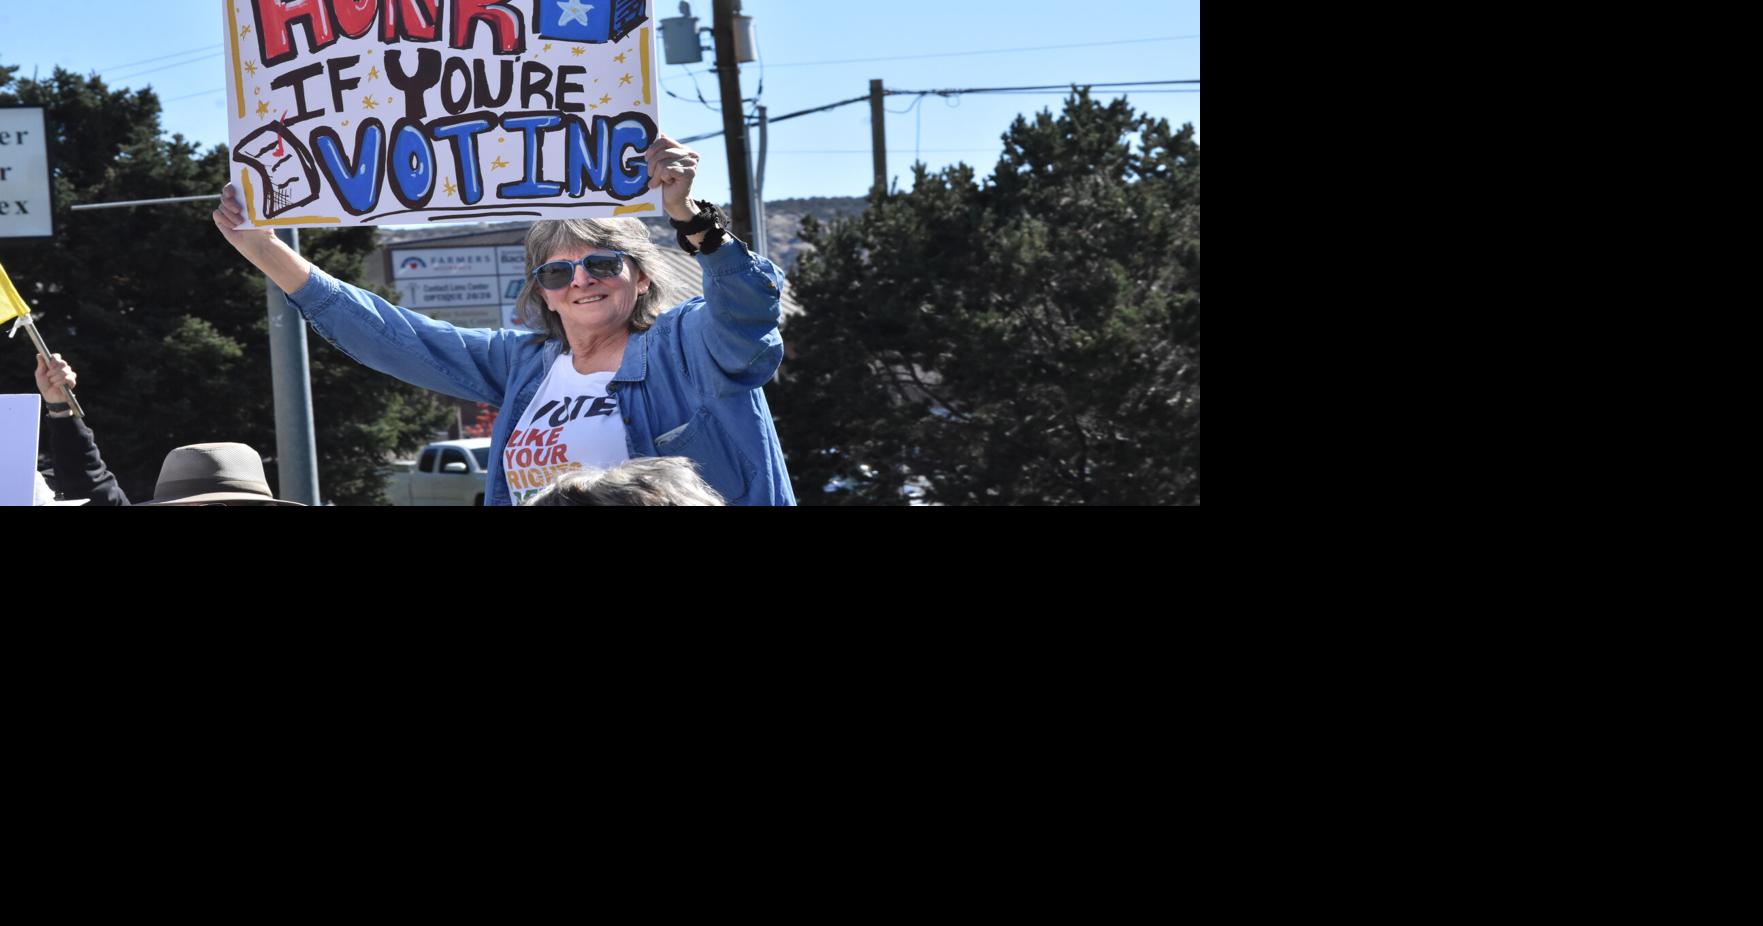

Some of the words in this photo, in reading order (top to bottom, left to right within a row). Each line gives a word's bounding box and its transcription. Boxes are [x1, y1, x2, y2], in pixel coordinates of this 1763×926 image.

[271, 55, 361, 127] IF
[384, 48, 587, 119] YOU'RE
[0, 131, 29, 145] er
[309, 111, 658, 215] VOTING
[430, 255, 491, 264] FARMERS
[507, 427, 564, 448] LIKE
[505, 444, 569, 469] YOUR
